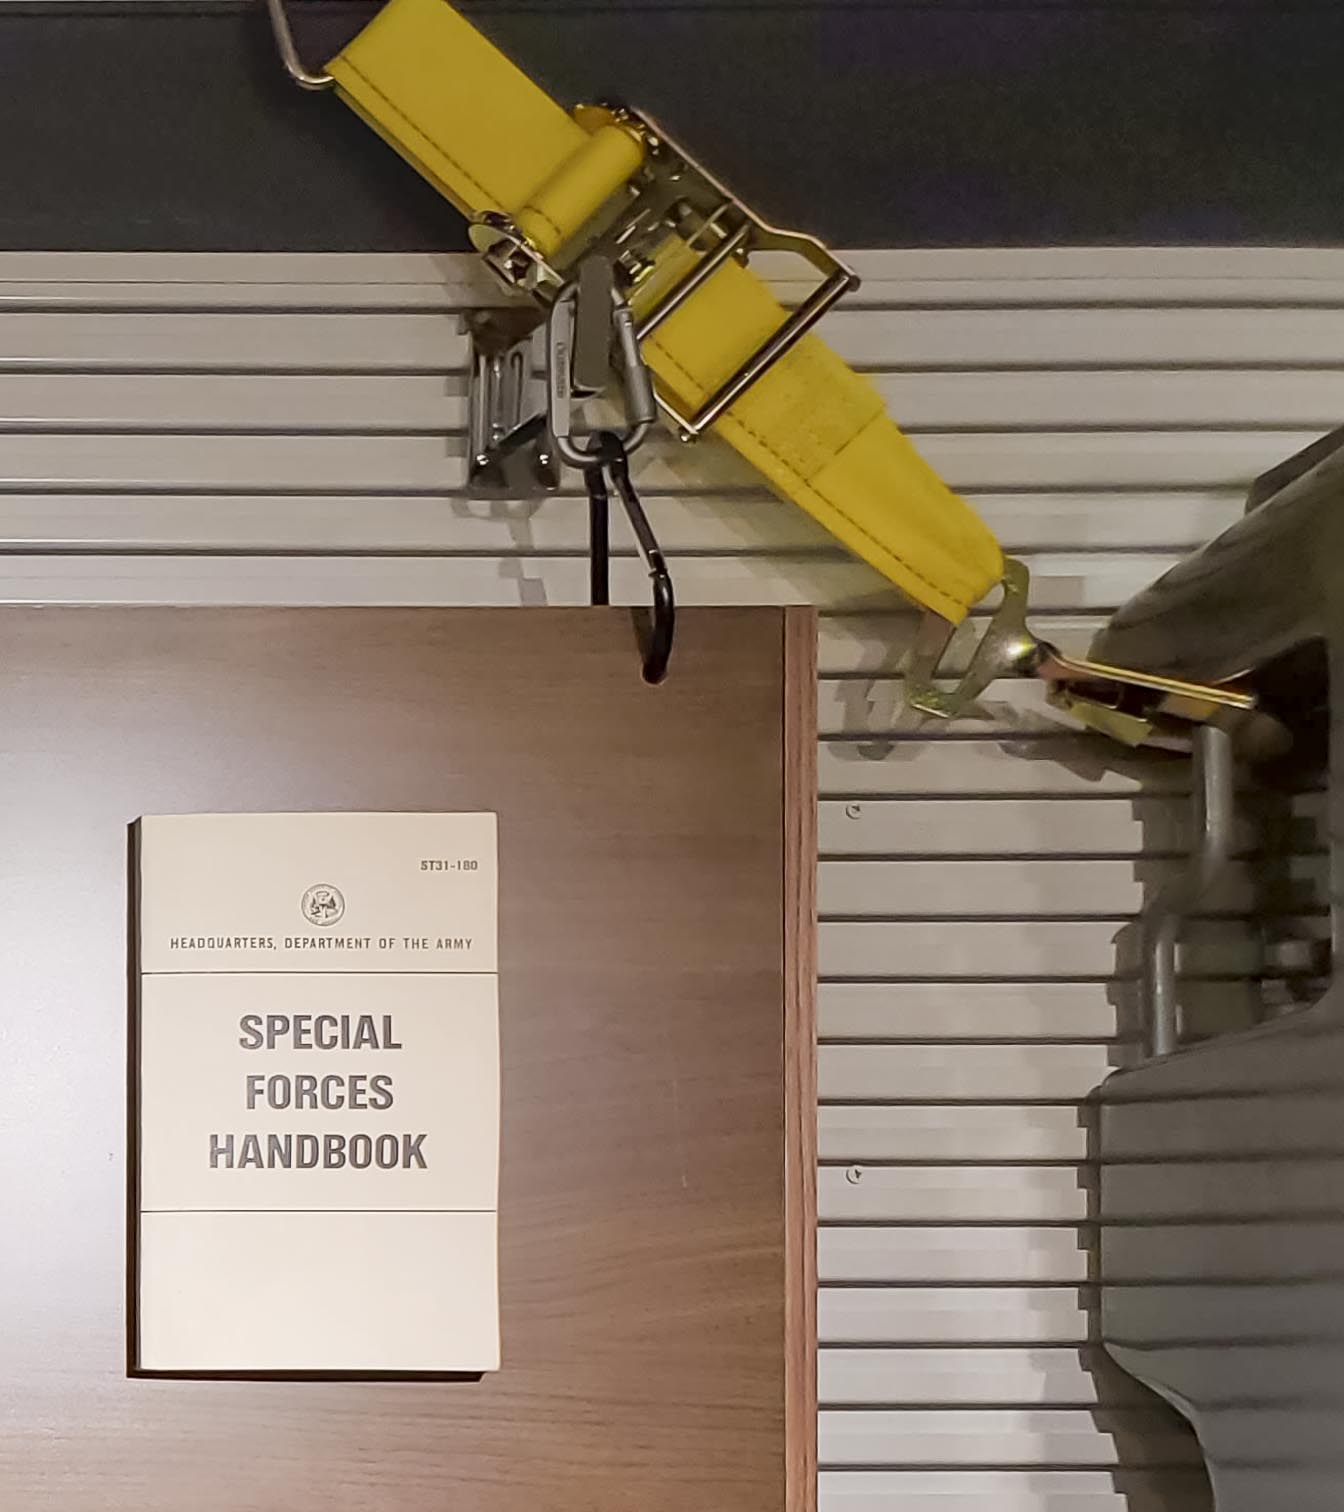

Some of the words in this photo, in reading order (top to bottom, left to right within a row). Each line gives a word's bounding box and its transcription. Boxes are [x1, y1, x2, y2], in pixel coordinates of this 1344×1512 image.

[170, 937, 277, 950] HEADQUARTERS,
[285, 937, 370, 949] DEPARTMENT
[379, 937, 394, 949] OF
[403, 937, 429, 949] THE
[437, 938, 473, 949] ARMY
[239, 1015, 402, 1050] SPECIAL
[246, 1075, 393, 1110] FORCES
[209, 1134, 428, 1169] HANDBOOK
